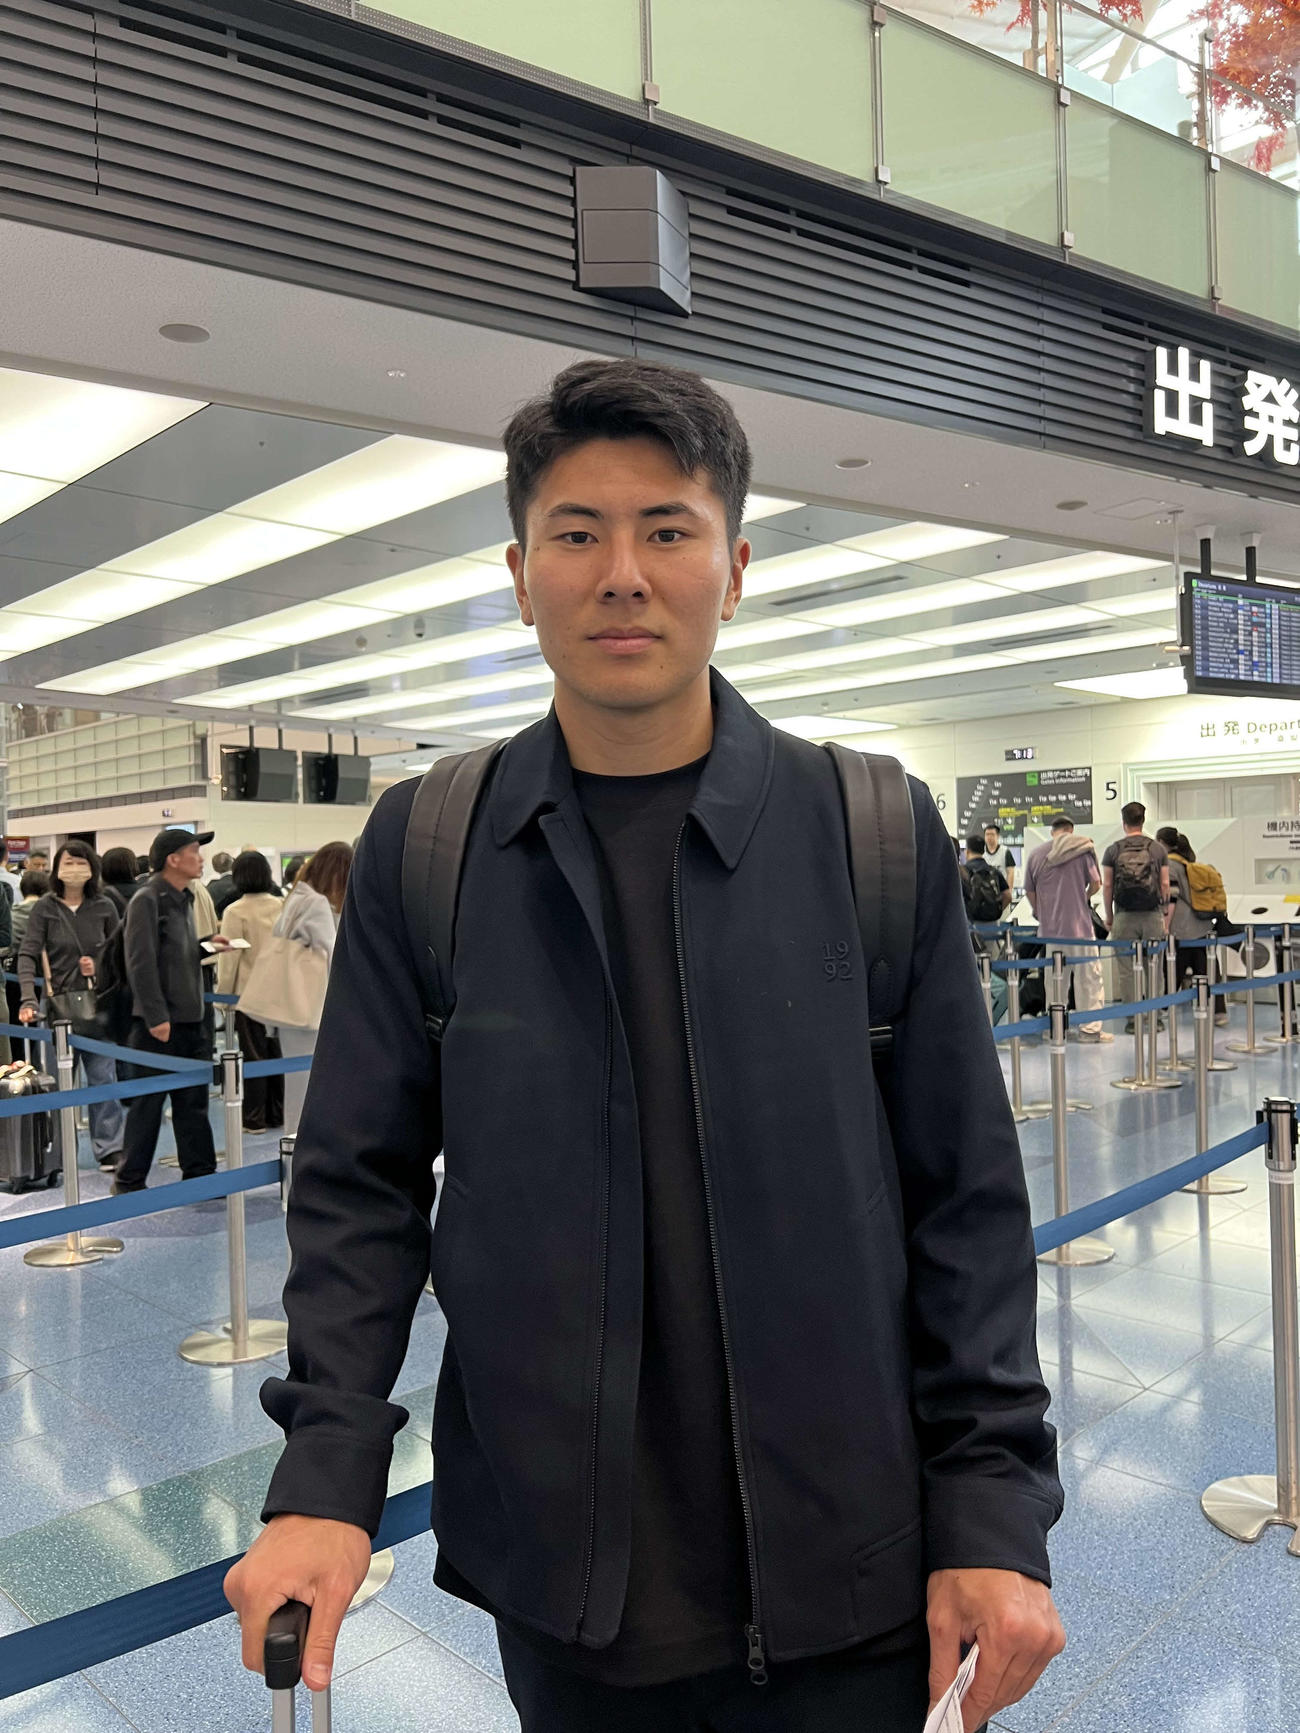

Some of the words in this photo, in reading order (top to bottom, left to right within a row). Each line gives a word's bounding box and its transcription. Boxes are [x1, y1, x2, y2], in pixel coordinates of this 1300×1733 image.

[1153, 346, 1300, 466] 出発
[1200, 721, 1240, 738] 出発
[1105, 781, 1118, 800] 5
[936, 793, 946, 811] 6
[823, 940, 849, 961] 19
[824, 962, 853, 983] 92
